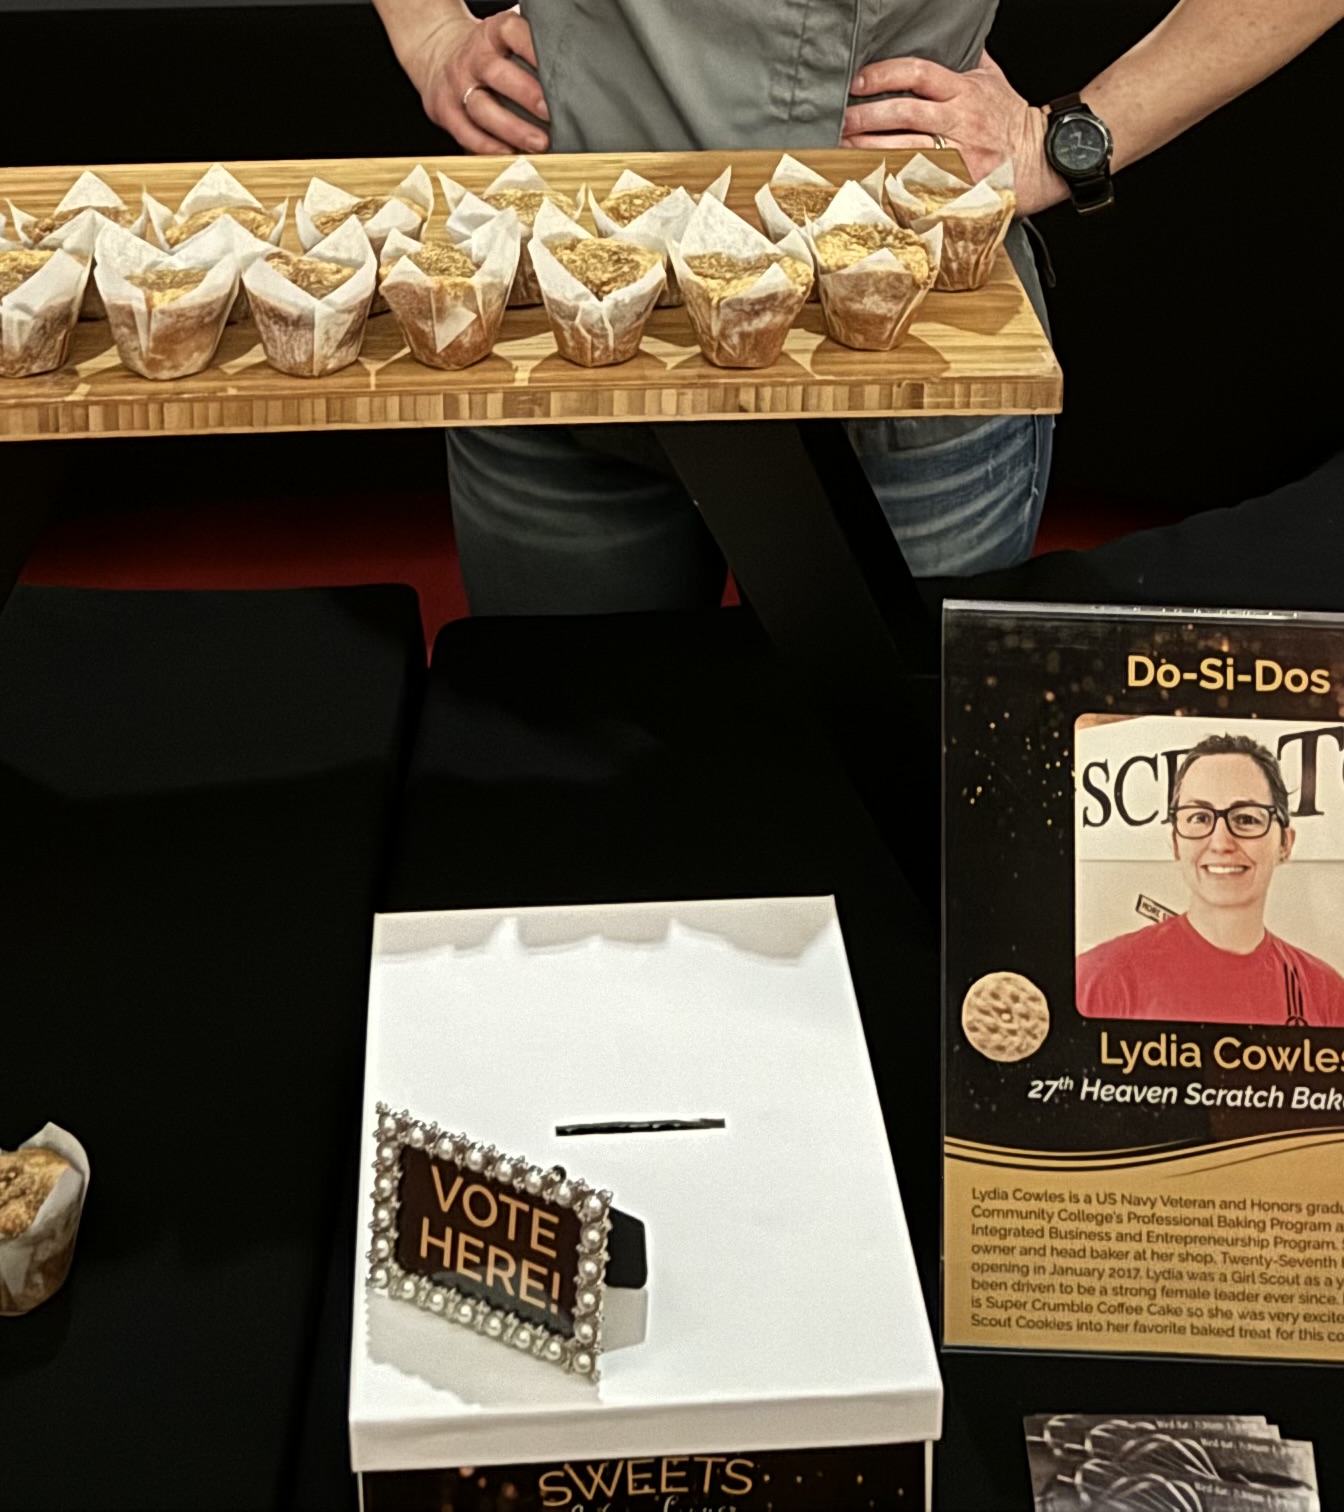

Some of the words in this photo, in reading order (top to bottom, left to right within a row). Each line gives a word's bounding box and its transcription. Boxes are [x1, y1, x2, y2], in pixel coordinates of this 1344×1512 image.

[1127, 655, 1331, 694] Do-Si-Dos
[1101, 1032, 1202, 1075] Lydia
[1027, 1076, 1074, 1103] 27th
[1080, 1077, 1178, 1105] Heaven
[1184, 1082, 1285, 1109] Scratch
[431, 1164, 560, 1259] VOTE
[972, 1187, 1009, 1203] Lydia
[1012, 1188, 1066, 1203] Cowles
[1069, 1191, 1080, 1204] is
[1084, 1194, 1093, 1205] a
[1096, 1192, 1118, 1205] US
[1121, 1193, 1158, 1210] Navy
[1160, 1195, 1216, 1209] Veteran
[1219, 1198, 1247, 1211] and
[1251, 1199, 1303, 1213] Honors
[971, 1205, 1055, 1223] Community
[1058, 1209, 1124, 1226] College's
[1127, 1212, 1214, 1227] Professional
[1218, 1215, 1267, 1233] Baking
[1270, 1217, 1332, 1234] Program
[972, 1224, 1045, 1240] Integrated
[1049, 1226, 1112, 1241] Business
[1116, 1231, 1143, 1243] and
[1146, 1231, 1270, 1249] Entrepreneurship
[420, 1216, 561, 1315] HERE!
[971, 1244, 1016, 1255] owner
[1020, 1245, 1047, 1257] and
[1050, 1246, 1087, 1259] head
[1090, 1247, 1130, 1260] baker
[1134, 1249, 1148, 1261] at
[1151, 1249, 1175, 1262] her
[1221, 1252, 1338, 1269] Twenty-Seventh
[971, 1262, 1030, 1277] opening
[1034, 1265, 1046, 1275] in
[1050, 1264, 1106, 1280] January
[1146, 1268, 1184, 1283] Lydia
[1187, 1271, 1215, 1282] was
[1219, 1272, 1228, 1283] a
[1232, 1271, 1256, 1284] Girl
[1259, 1272, 1301, 1286] Scout
[1304, 1276, 1321, 1287] as
[1324, 1277, 1334, 1287] a
[971, 1278, 1008, 1291] been
[1011, 1280, 1056, 1294] driven
[1059, 1282, 1074, 1295] to
[1077, 1282, 1096, 1296] be
[1099, 1286, 1108, 1296] a
[1112, 1285, 1157, 1301] strong
[1161, 1285, 1211, 1299] female
[1214, 1288, 1260, 1302] leader
[1263, 1293, 1295, 1304] ever
[971, 1296, 982, 1309] is
[986, 1296, 1028, 1311] Super
[1032, 1299, 1094, 1313] Crumble
[1097, 1301, 1144, 1315] Coffee
[1147, 1303, 1184, 1317] Cake
[1187, 1307, 1204, 1318] so
[1208, 1306, 1234, 1320] she
[1238, 1311, 1266, 1321] was
[1268, 1312, 1300, 1325] very
[971, 1313, 1012, 1328] Scout
[1016, 1316, 1073, 1331] Cookies
[1076, 1319, 1104, 1332] into
[1107, 1321, 1130, 1333] her
[1134, 1320, 1187, 1335] favorite
[1190, 1324, 1236, 1338] baked
[1239, 1326, 1271, 1339] treat
[1276, 1327, 1295, 1341] for
[1298, 1328, 1324, 1342] this
[538, 1457, 755, 1507] SWEETS
